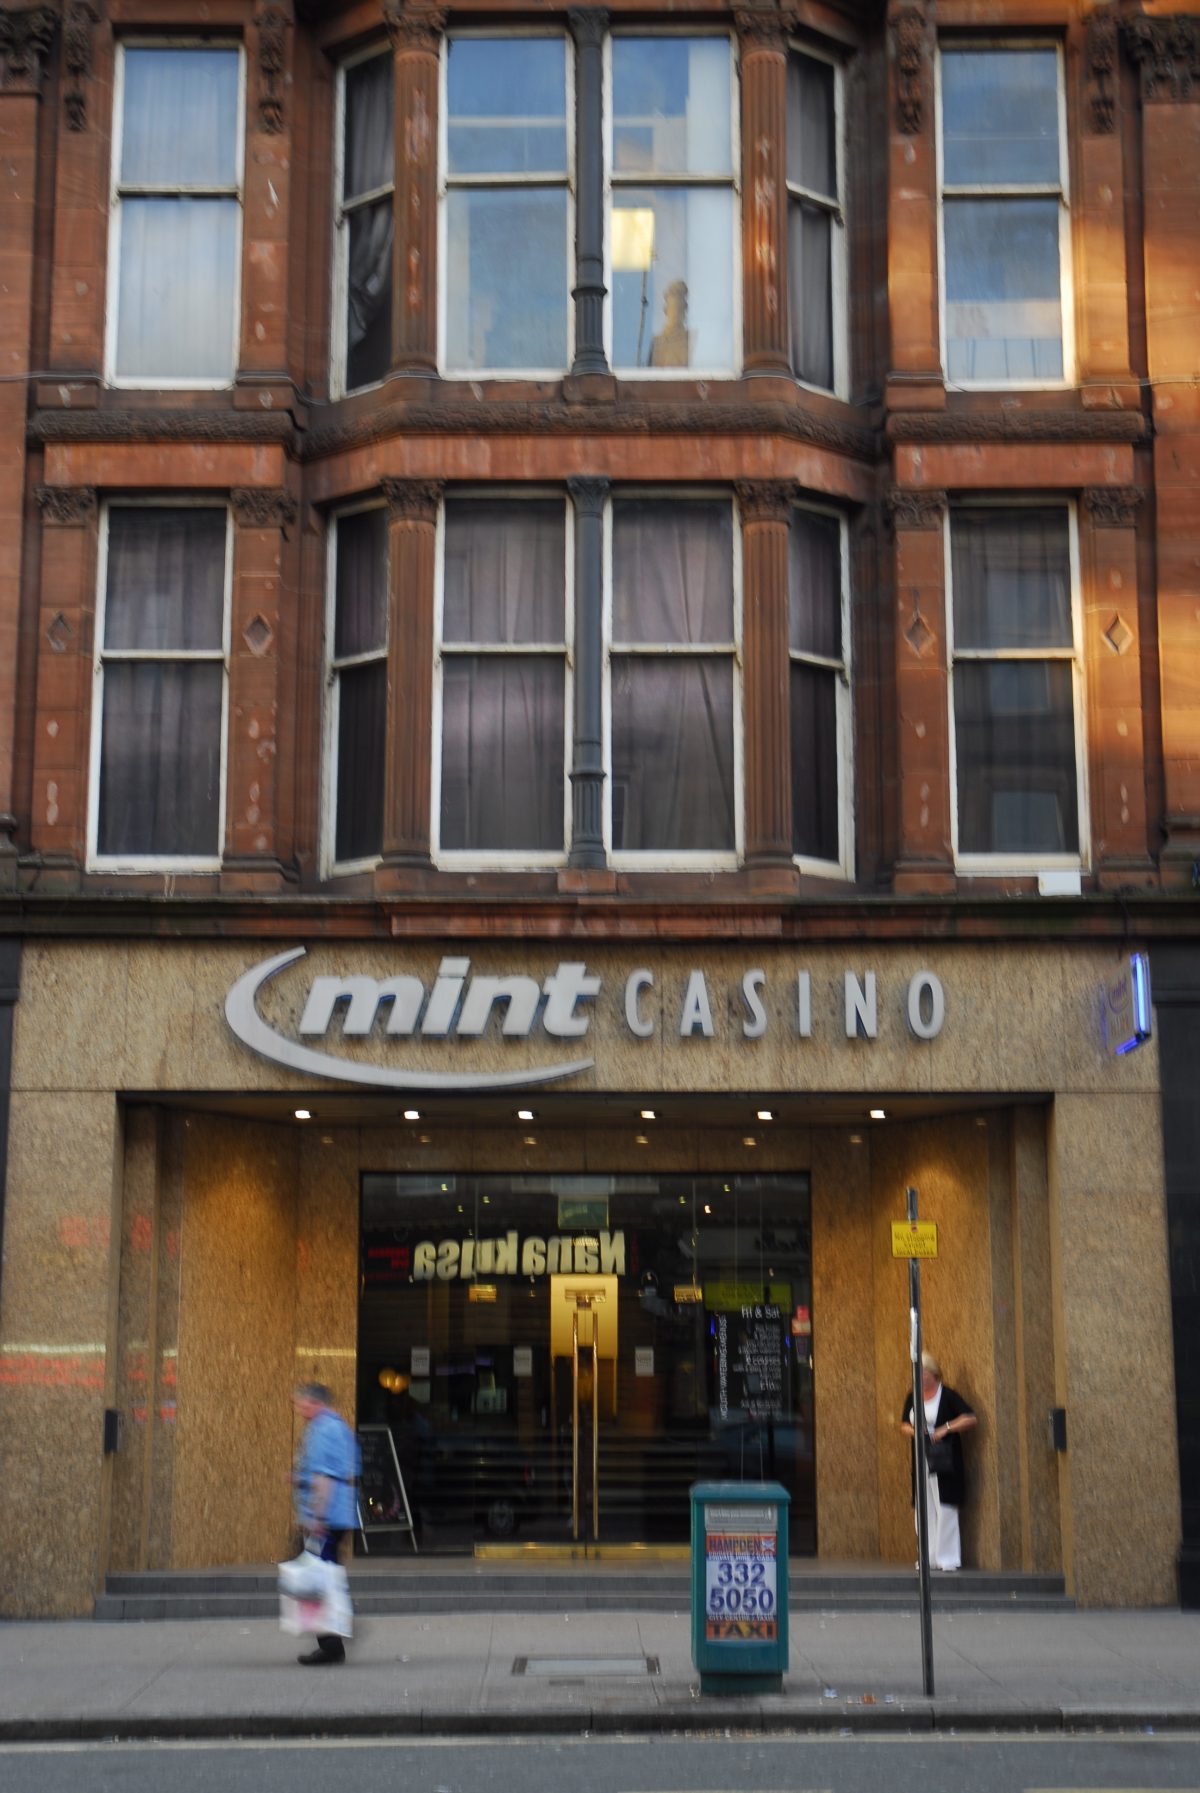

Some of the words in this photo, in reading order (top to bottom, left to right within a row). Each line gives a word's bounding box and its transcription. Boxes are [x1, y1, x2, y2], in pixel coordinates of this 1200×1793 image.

[300, 956, 600, 1038] mint
[624, 968, 946, 1040] CASINO
[709, 1538, 762, 1553] HAMPDEN
[718, 1562, 766, 1587] 332
[709, 1588, 774, 1612] 5050
[709, 1621, 775, 1638] TAXI
